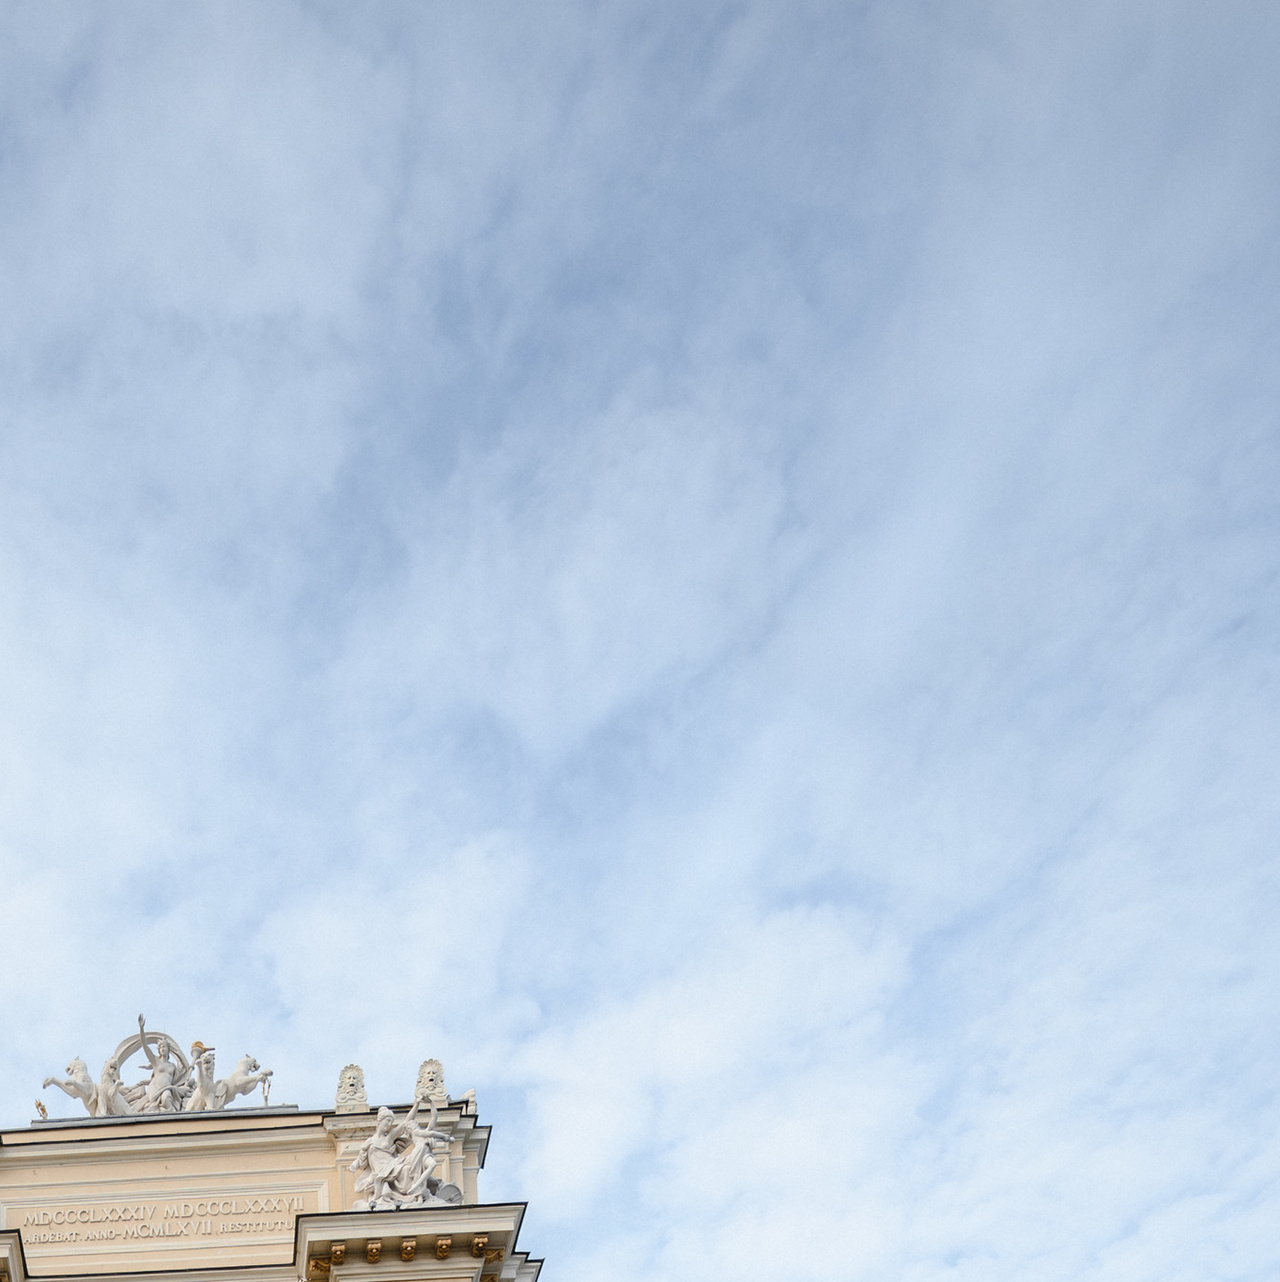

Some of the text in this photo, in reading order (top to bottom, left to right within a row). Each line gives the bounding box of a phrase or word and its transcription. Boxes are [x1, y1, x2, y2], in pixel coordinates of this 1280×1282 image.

[23, 1197, 304, 1227] MDCCCLXXXIV MDCCCLXXXVII
[220, 1220, 296, 1235] RESTITUTU
